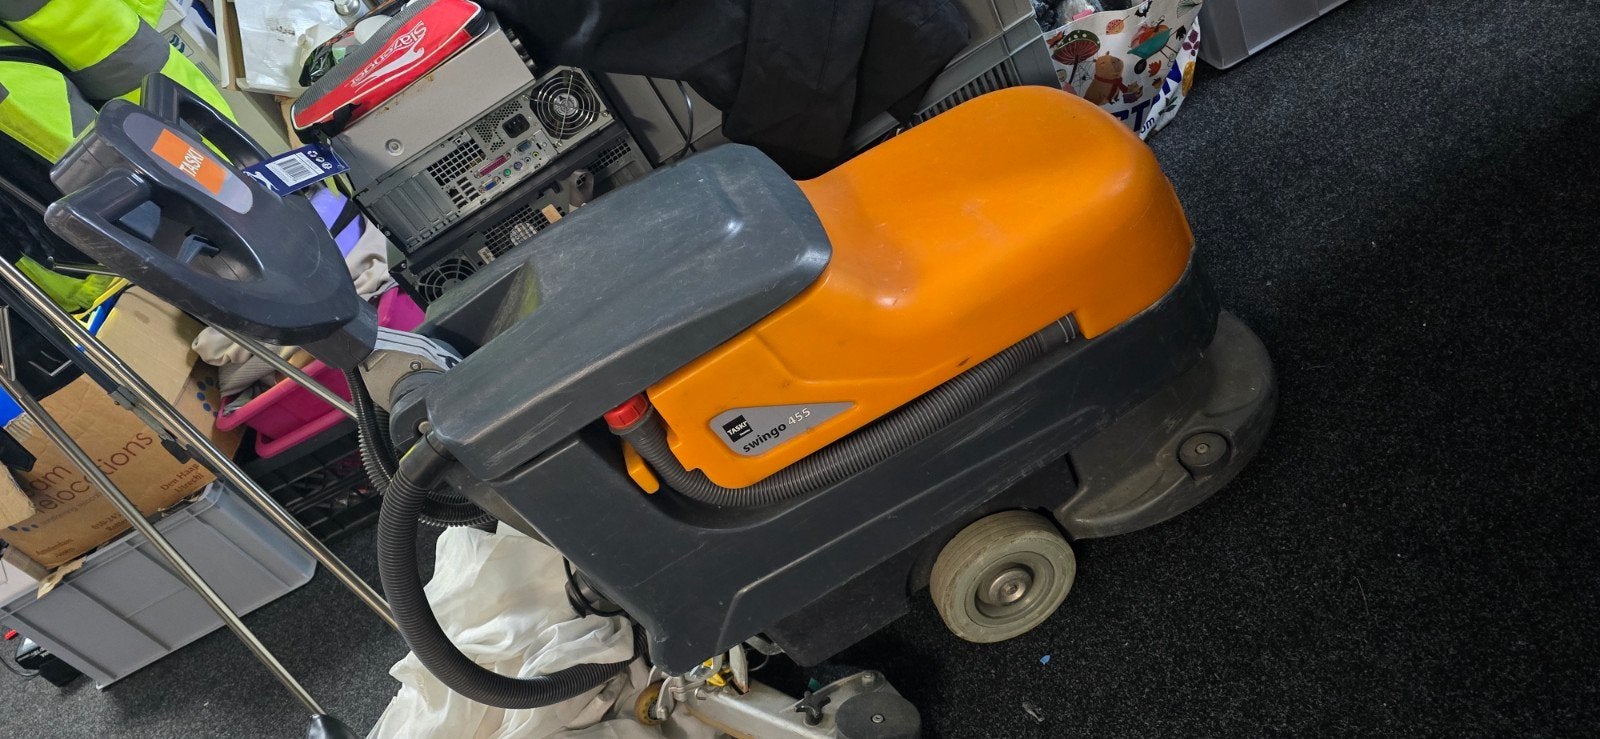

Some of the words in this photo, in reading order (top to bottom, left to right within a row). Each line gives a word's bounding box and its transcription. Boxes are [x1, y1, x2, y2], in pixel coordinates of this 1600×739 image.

[351, 20, 427, 87] Slazenger
[179, 147, 205, 177] TASKI
[726, 420, 748, 436] TASKI
[742, 423, 787, 453] swingo
[788, 407, 811, 425] 455
[160, 478, 178, 490] Den
